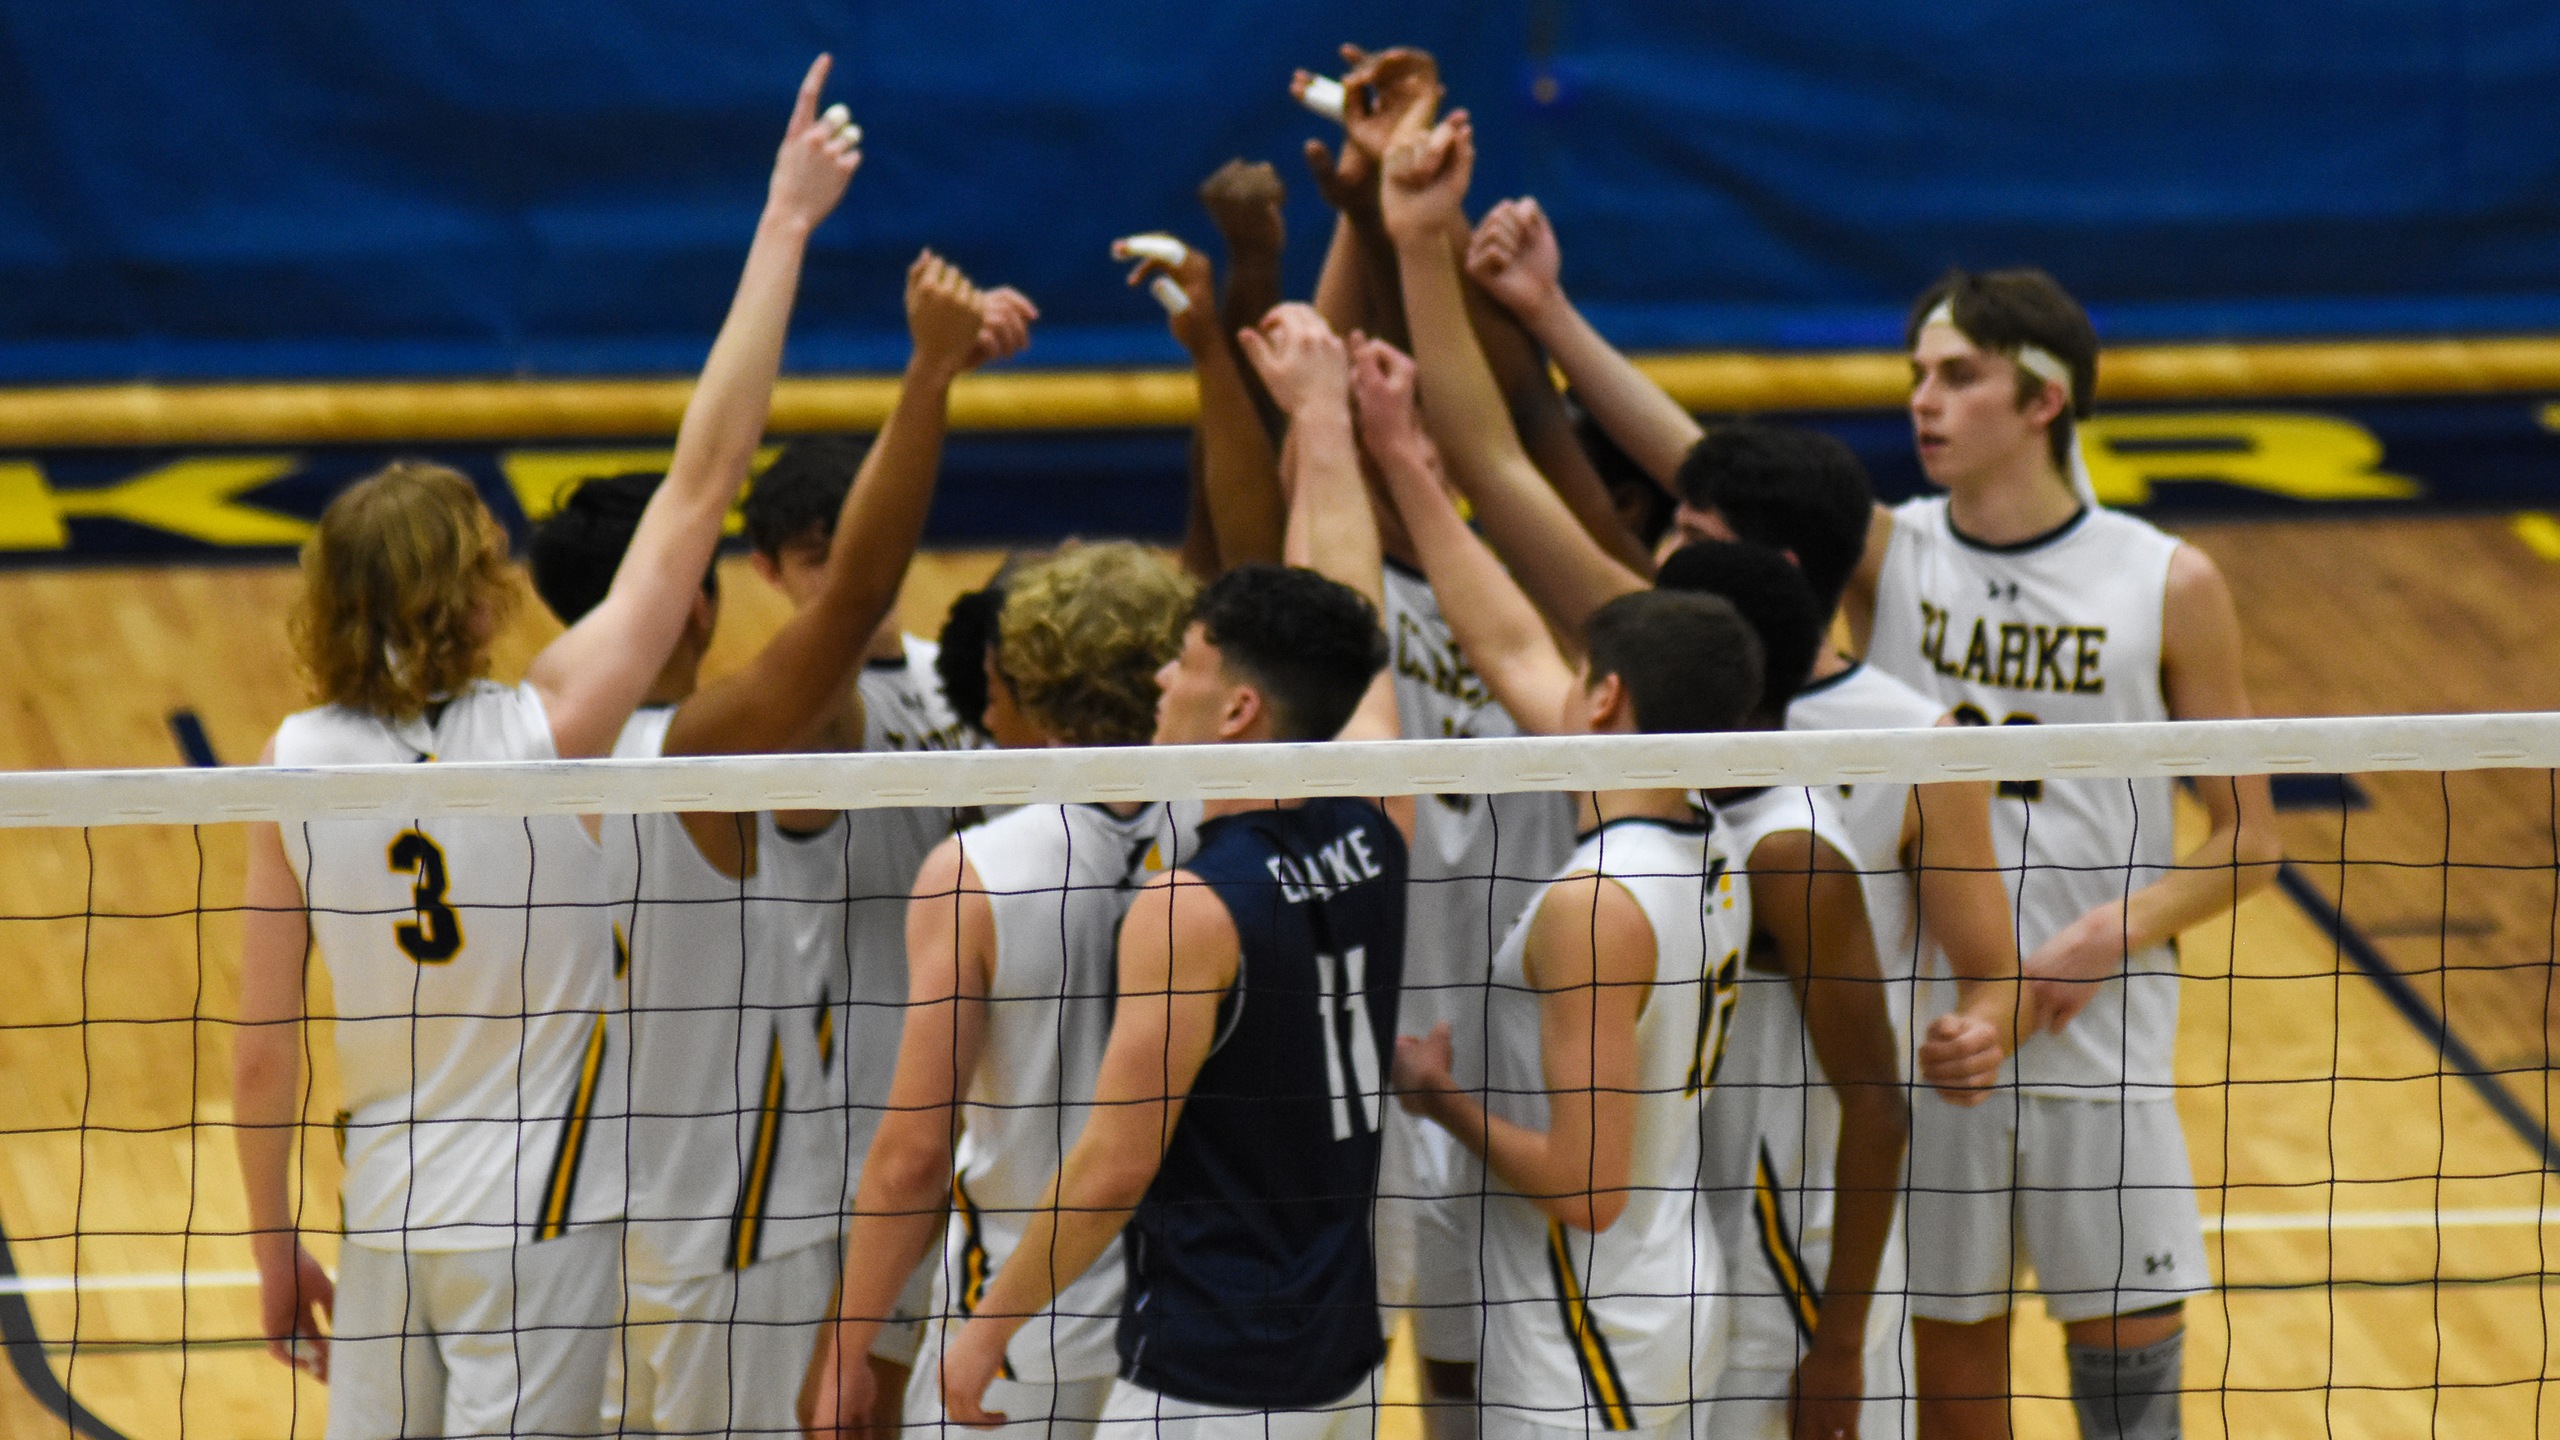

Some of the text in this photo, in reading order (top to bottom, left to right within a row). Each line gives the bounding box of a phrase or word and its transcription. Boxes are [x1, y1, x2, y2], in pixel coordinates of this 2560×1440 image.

[1920, 599, 2106, 693] CLARKE
[385, 827, 467, 968] 3
[1264, 826, 1383, 904] CLAKE
[1315, 945, 1382, 1142] 11
